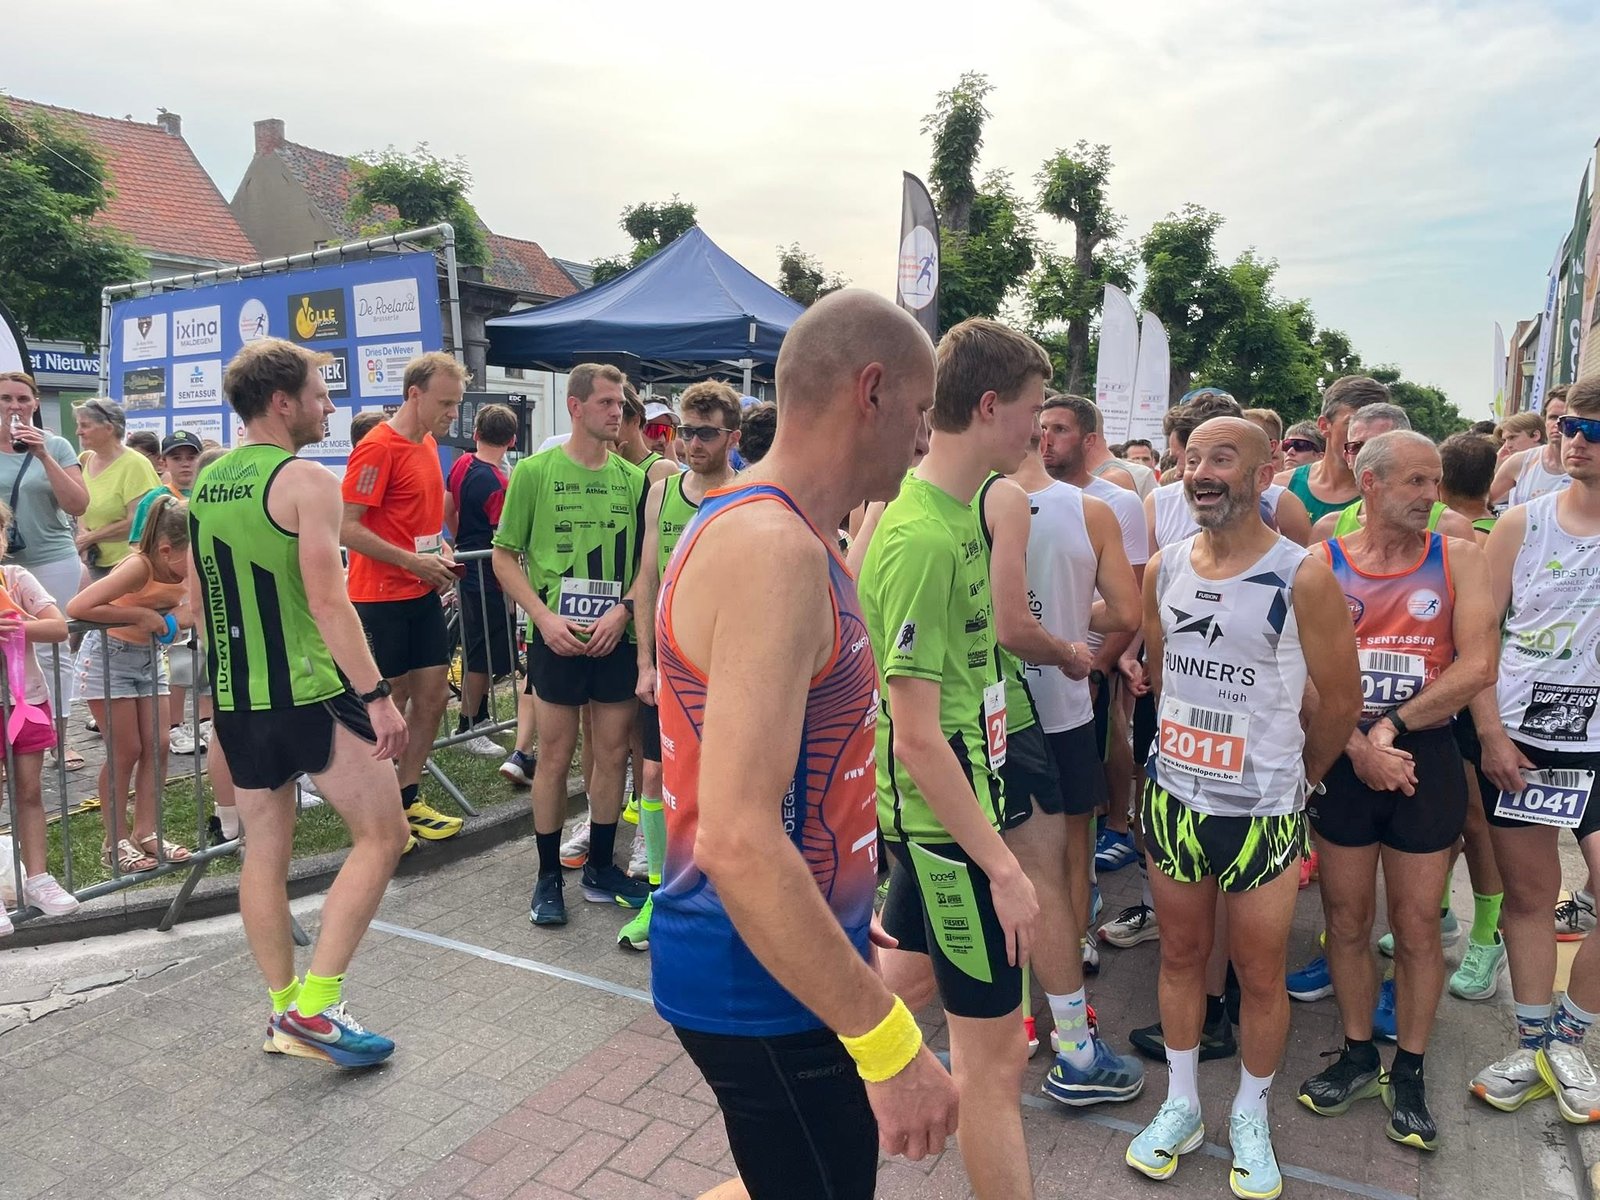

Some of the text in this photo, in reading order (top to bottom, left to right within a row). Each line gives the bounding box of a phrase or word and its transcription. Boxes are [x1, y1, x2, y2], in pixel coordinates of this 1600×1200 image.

[359, 296, 416, 317] De Roeland
[176, 318, 218, 340] ixina
[180, 337, 214, 347] MALDEGEM
[365, 345, 415, 357] Dries De Wever
[45, 353, 100, 373] Nieuws
[190, 376, 204, 384] KBC
[178, 389, 217, 400] SENTASSUR
[330, 440, 351, 448] MOERE
[196, 483, 255, 503] Athlex
[1552, 567, 1600, 579] BDS TUI
[203, 555, 229, 693] LUCKY RUNNERS
[1367, 635, 1435, 646] SENTASSUR
[1361, 675, 1416, 701] 015
[1533, 683, 1598, 695] LANDBOUWWERKEN
[1218, 689, 1247, 703] High
[1533, 691, 1598, 708] BOELENS
[1163, 726, 1234, 767] 2011
[1508, 787, 1580, 816] 1041
